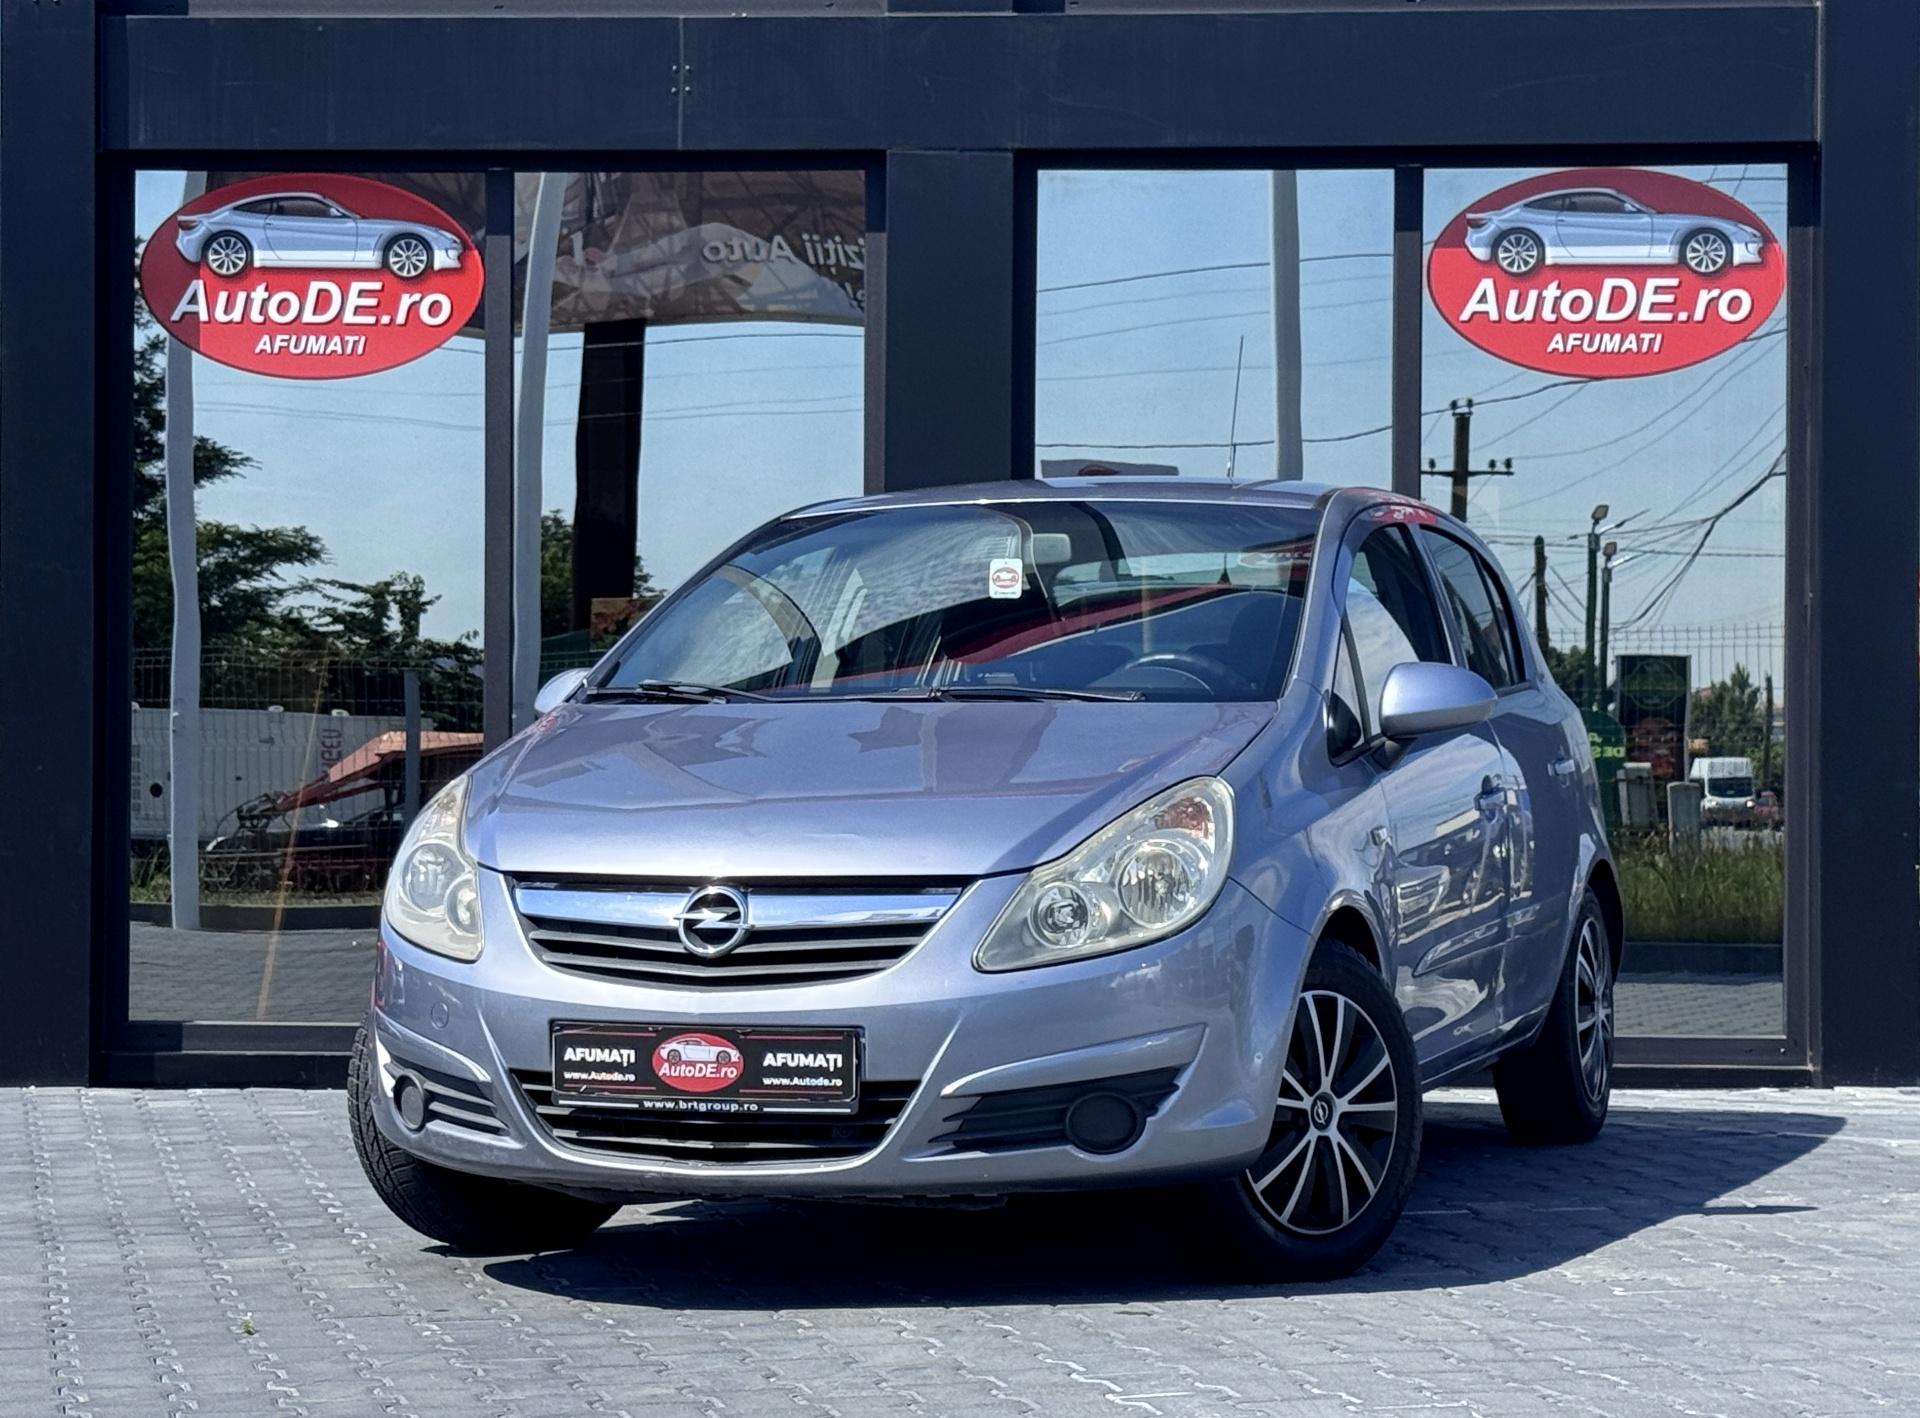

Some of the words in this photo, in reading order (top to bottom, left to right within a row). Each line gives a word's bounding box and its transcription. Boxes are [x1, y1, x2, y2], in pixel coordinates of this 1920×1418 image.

[170, 279, 453, 327] AutoDE.ro
[1459, 278, 1753, 324] AutoDE.ro
[255, 335, 366, 356] AFUMATI
[1547, 333, 1663, 354] AFUMATI
[563, 1071, 636, 1082] www.Autode.ro
[659, 1062, 738, 1079] AutoDE.ro
[762, 1077, 843, 1087] www.Autode.ro
[643, 1099, 759, 1112] www.brtgroup.ro
